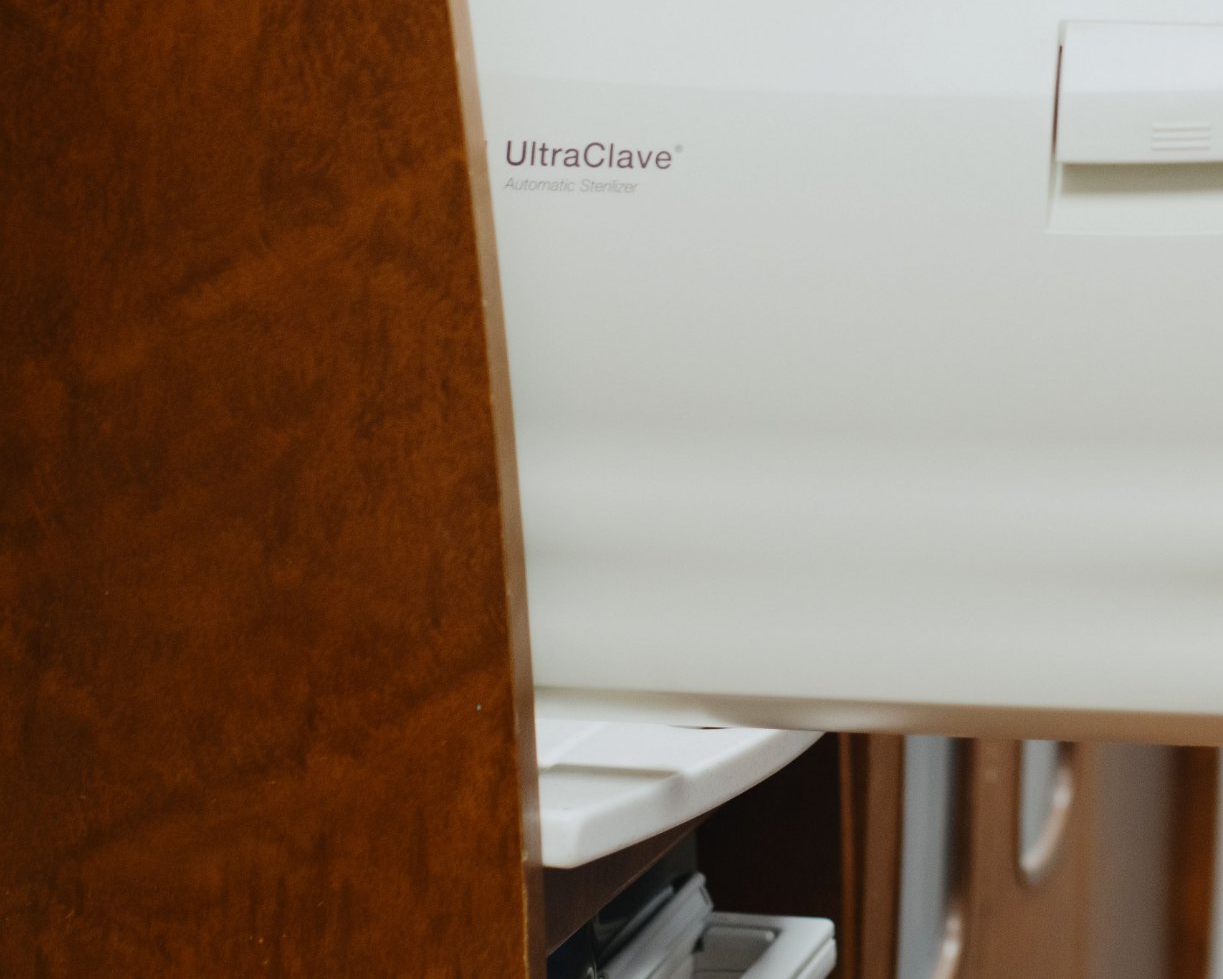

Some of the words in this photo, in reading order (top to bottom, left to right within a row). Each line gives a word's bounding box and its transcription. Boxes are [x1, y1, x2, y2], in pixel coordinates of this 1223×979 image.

[505, 140, 673, 170] UltraClave
[503, 177, 576, 192] Automatic
[579, 178, 639, 194] Sterilizer
